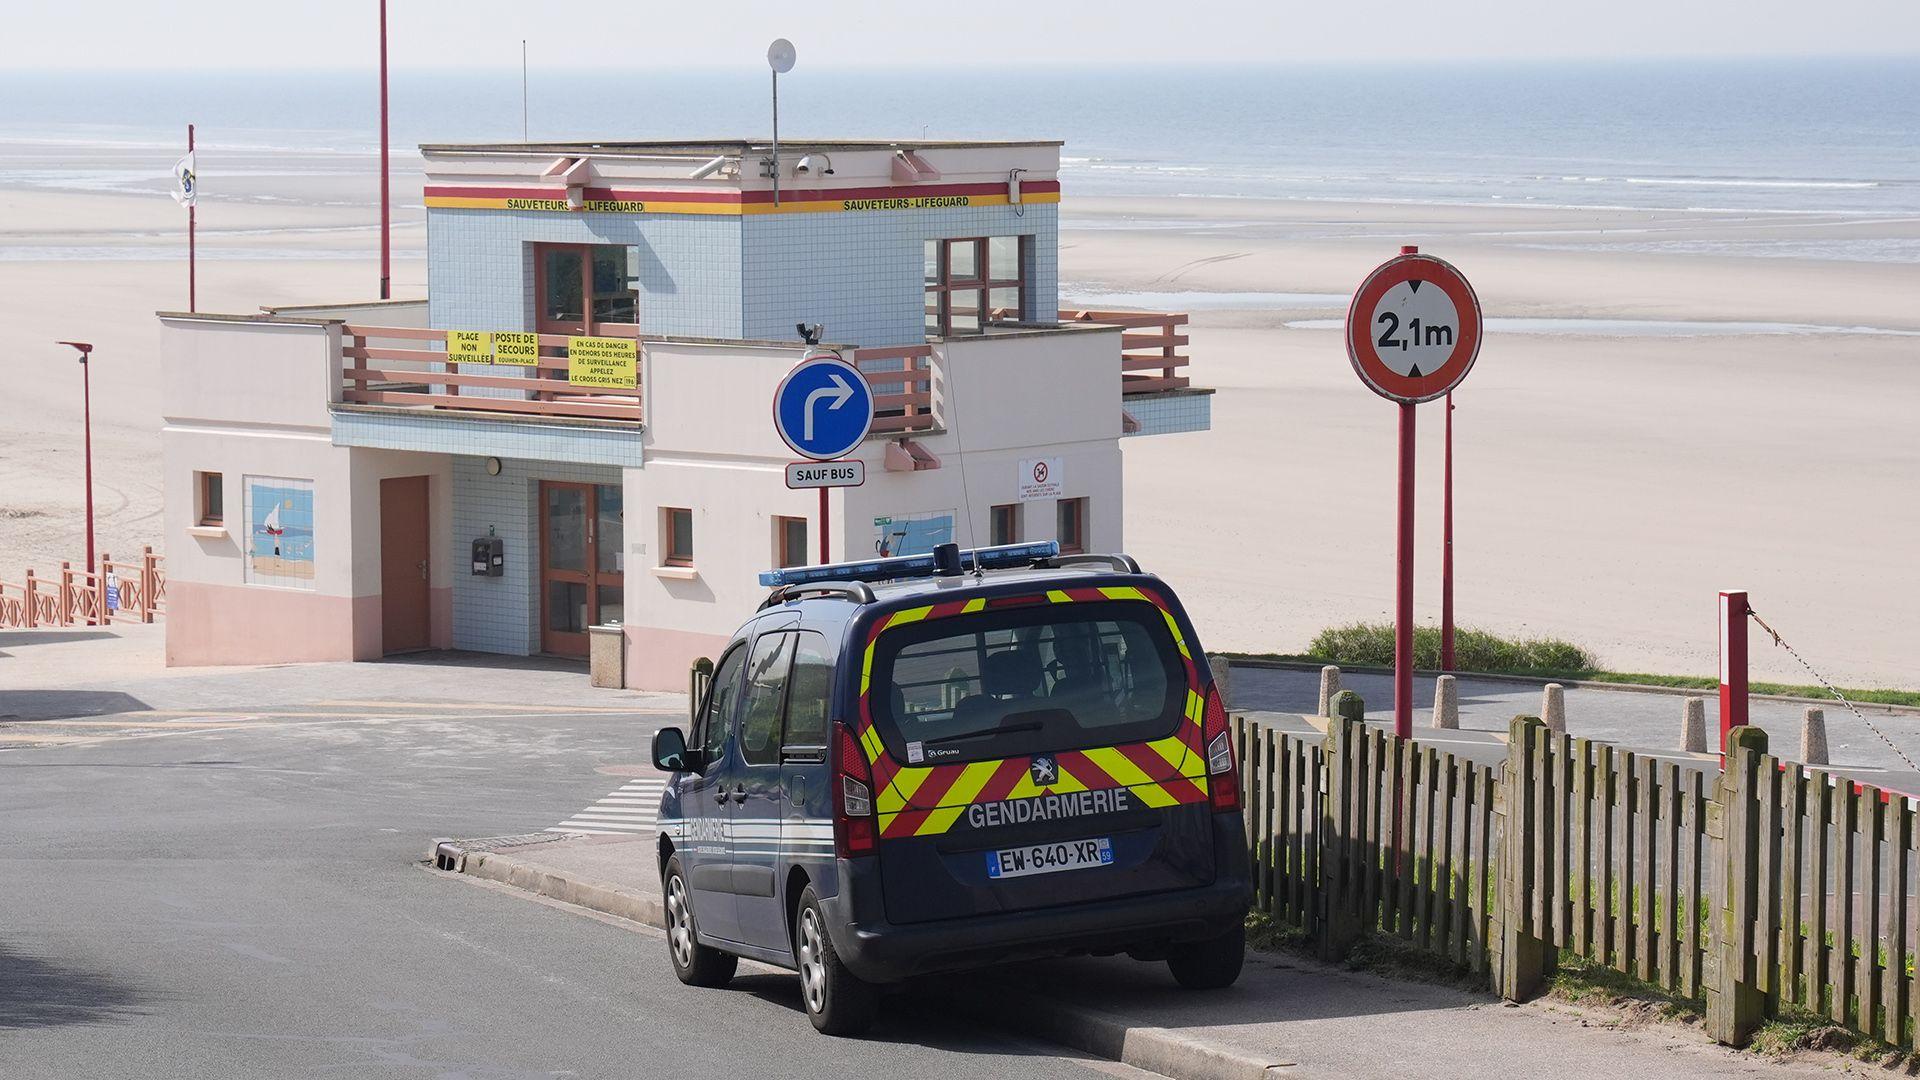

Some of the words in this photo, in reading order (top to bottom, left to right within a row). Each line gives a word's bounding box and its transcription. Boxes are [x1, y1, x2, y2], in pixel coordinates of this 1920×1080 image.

[588, 201, 643, 212] LIFEGUARD
[844, 198, 909, 211] SAUVETEURS
[915, 196, 969, 208] LIFEGUARD
[457, 332, 479, 341] PLAGE
[495, 333, 521, 343] POSTE
[523, 334, 535, 344] DE
[461, 343, 477, 352] NON
[498, 344, 535, 355] SECOURS
[613, 351, 636, 359] HEURES
[587, 359, 627, 367] SURVEILLANCE
[579, 375, 597, 383] CROSS
[796, 469, 828, 481] SAUF
[830, 467, 855, 480] BUS
[968, 787, 1129, 829] GENDARMERIE
[999, 841, 1100, 873] EW-640-XR
